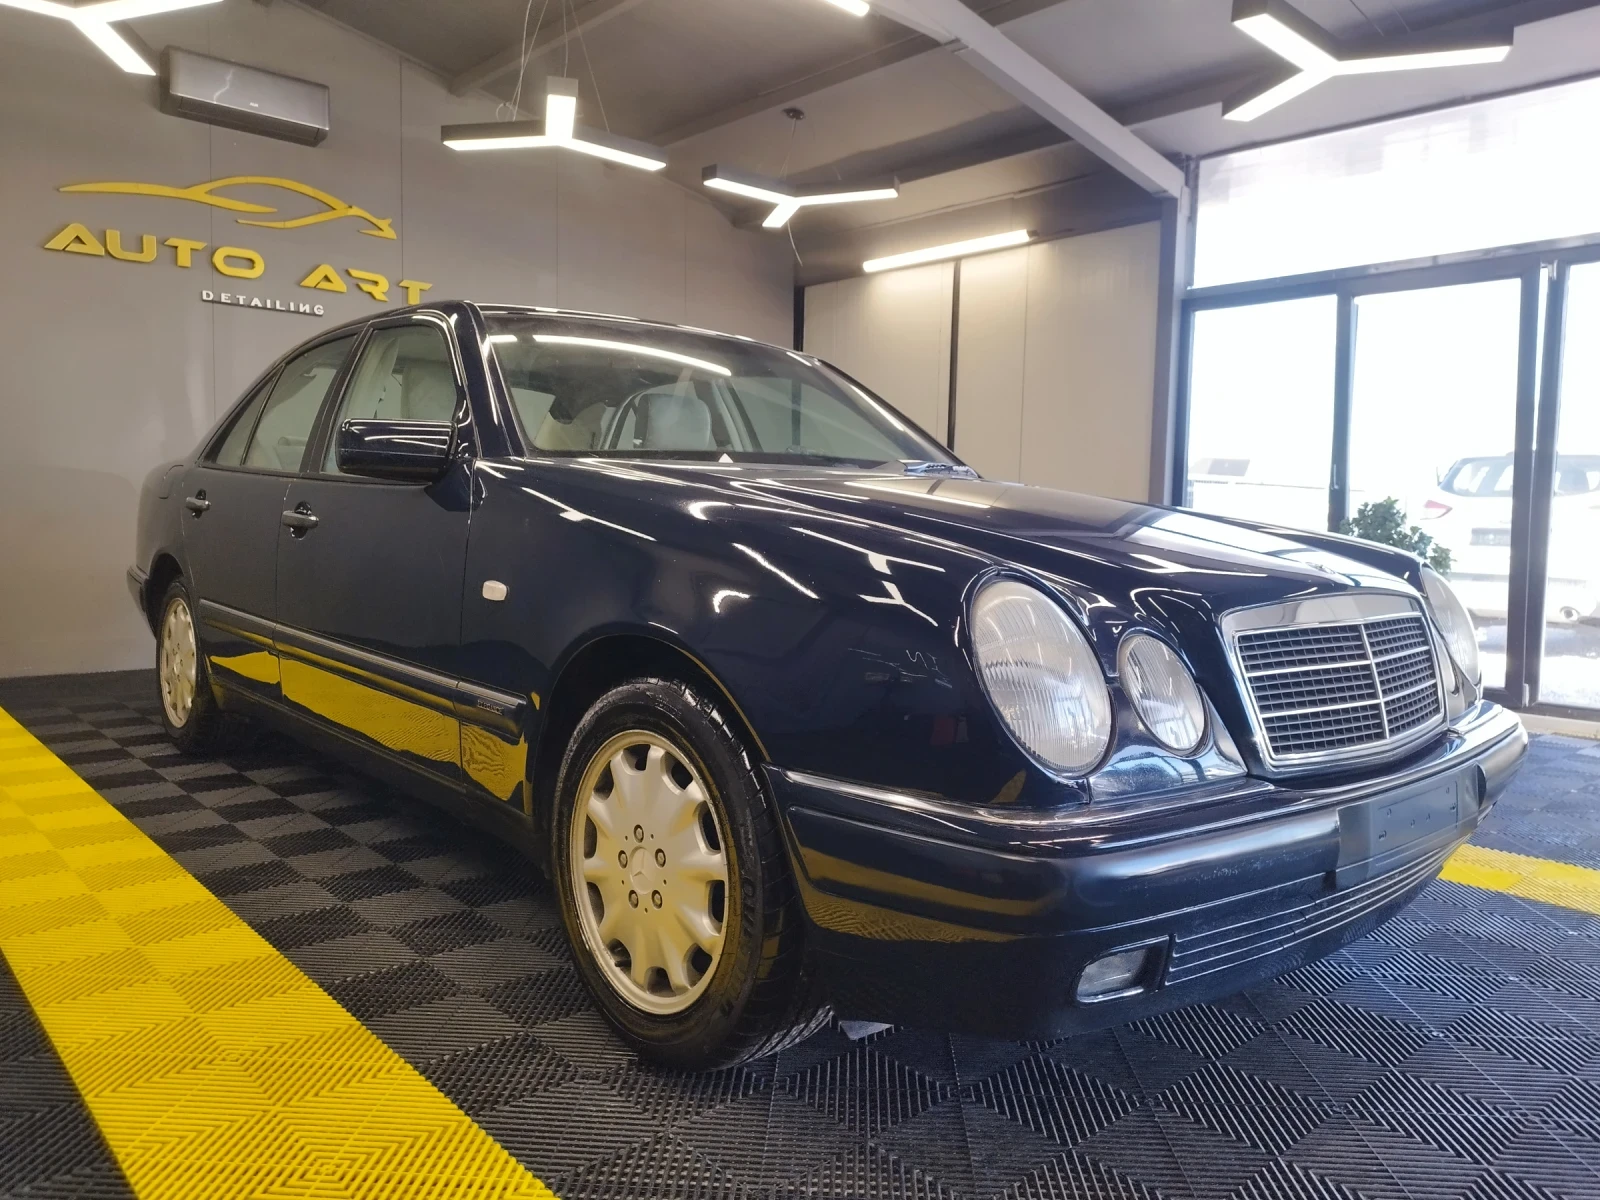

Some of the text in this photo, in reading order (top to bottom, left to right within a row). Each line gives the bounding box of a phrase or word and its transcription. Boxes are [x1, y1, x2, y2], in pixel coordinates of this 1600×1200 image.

[43, 223, 433, 305] AUTO ART
[201, 289, 325, 316] DETAILING
